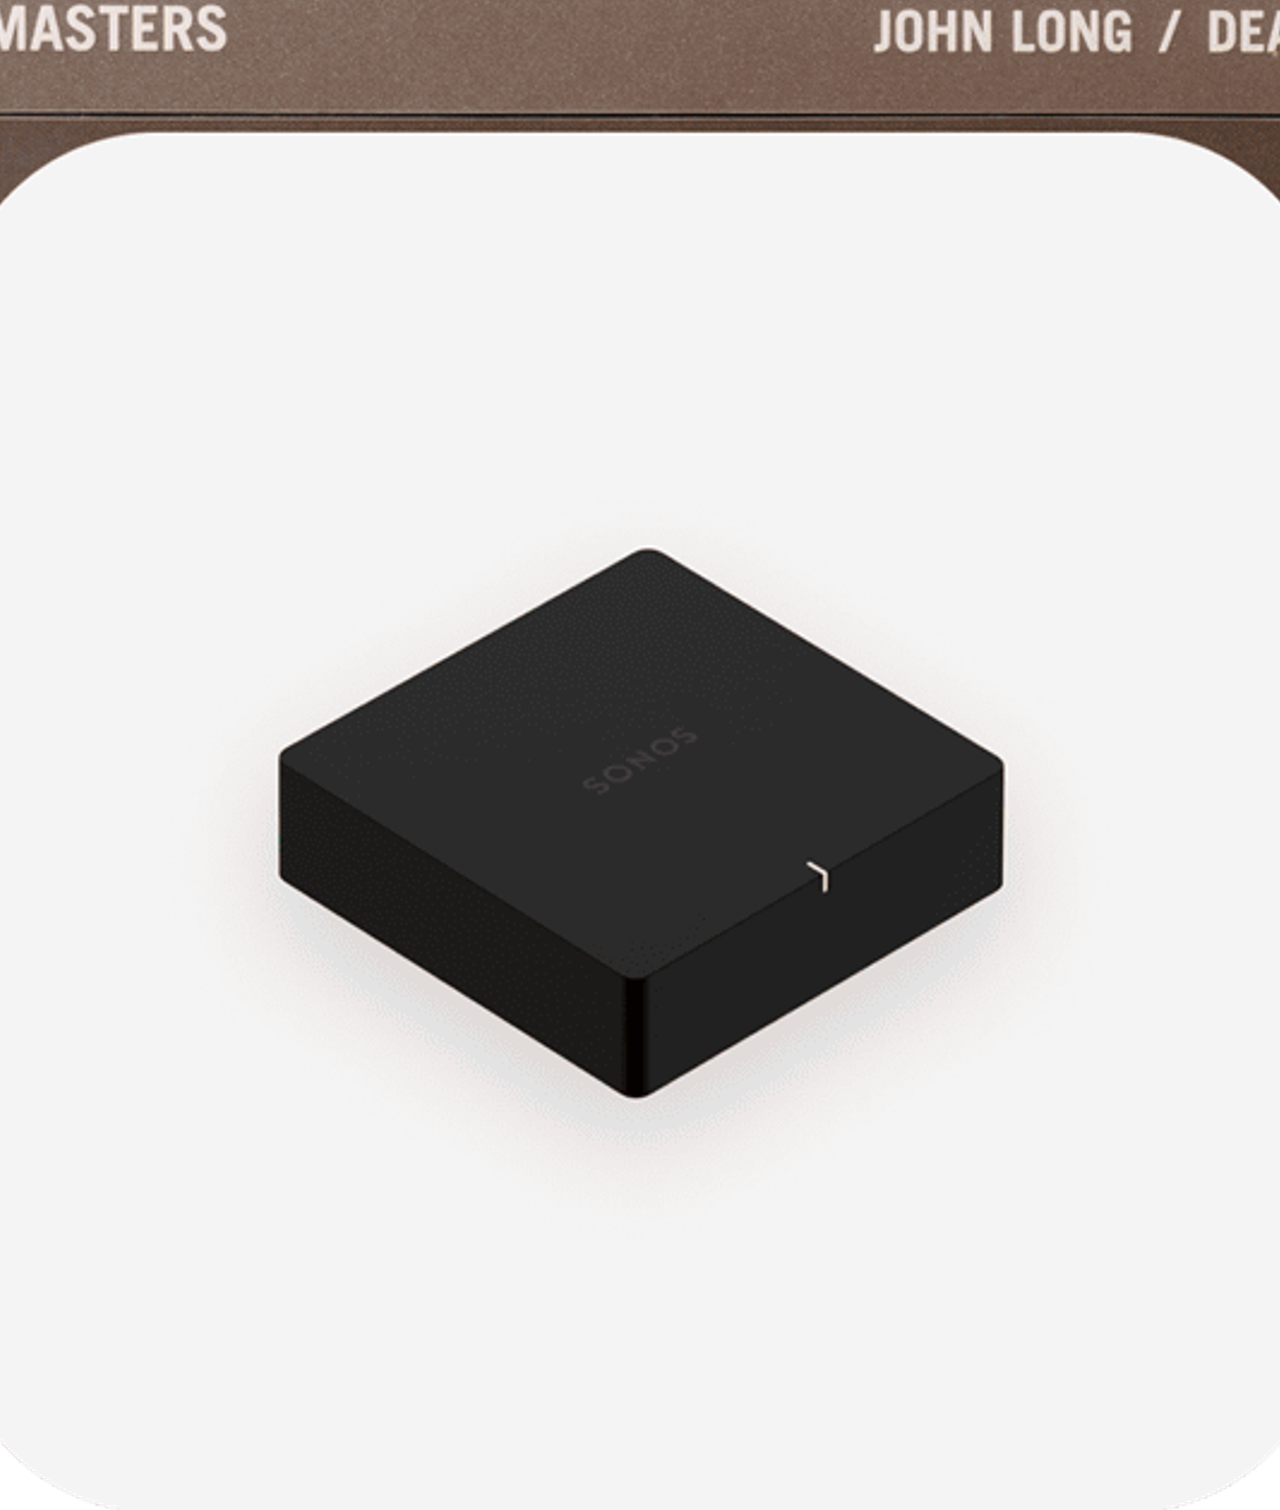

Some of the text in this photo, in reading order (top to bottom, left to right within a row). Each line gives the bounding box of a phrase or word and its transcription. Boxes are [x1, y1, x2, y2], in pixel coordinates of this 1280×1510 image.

[874, 10, 991, 54] JOHN
[1013, 10, 1132, 54] LONG
[583, 727, 697, 794] SONOS
